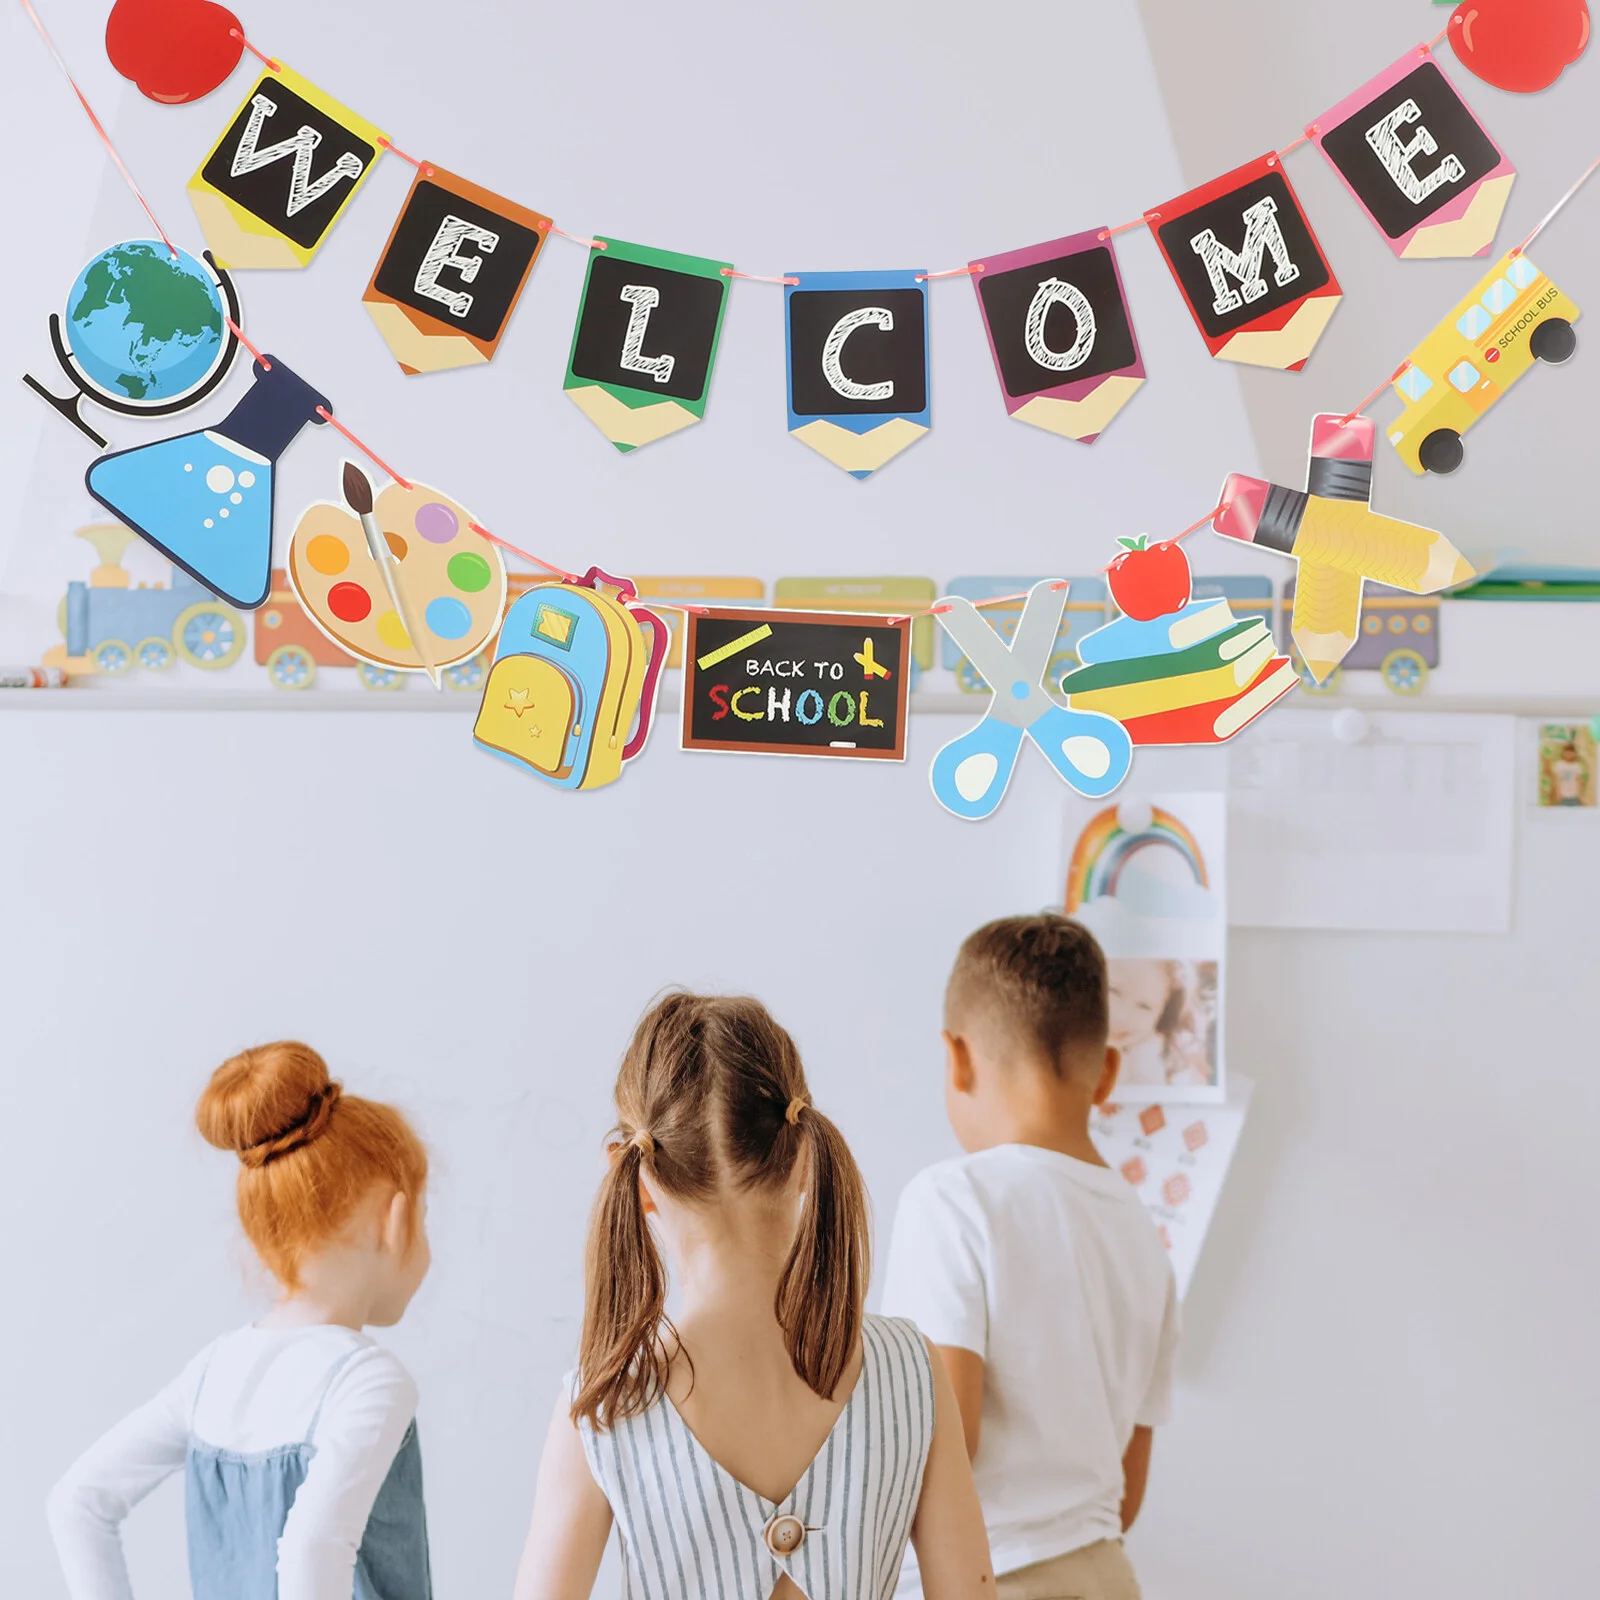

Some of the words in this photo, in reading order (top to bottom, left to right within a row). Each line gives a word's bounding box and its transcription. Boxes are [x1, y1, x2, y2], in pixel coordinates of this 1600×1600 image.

[1498, 309, 1540, 348] SCHOOL
[1536, 287, 1559, 310] BUS
[746, 658, 806, 678] BACK
[813, 660, 844, 680] TO
[708, 684, 884, 728] SCHOOL
